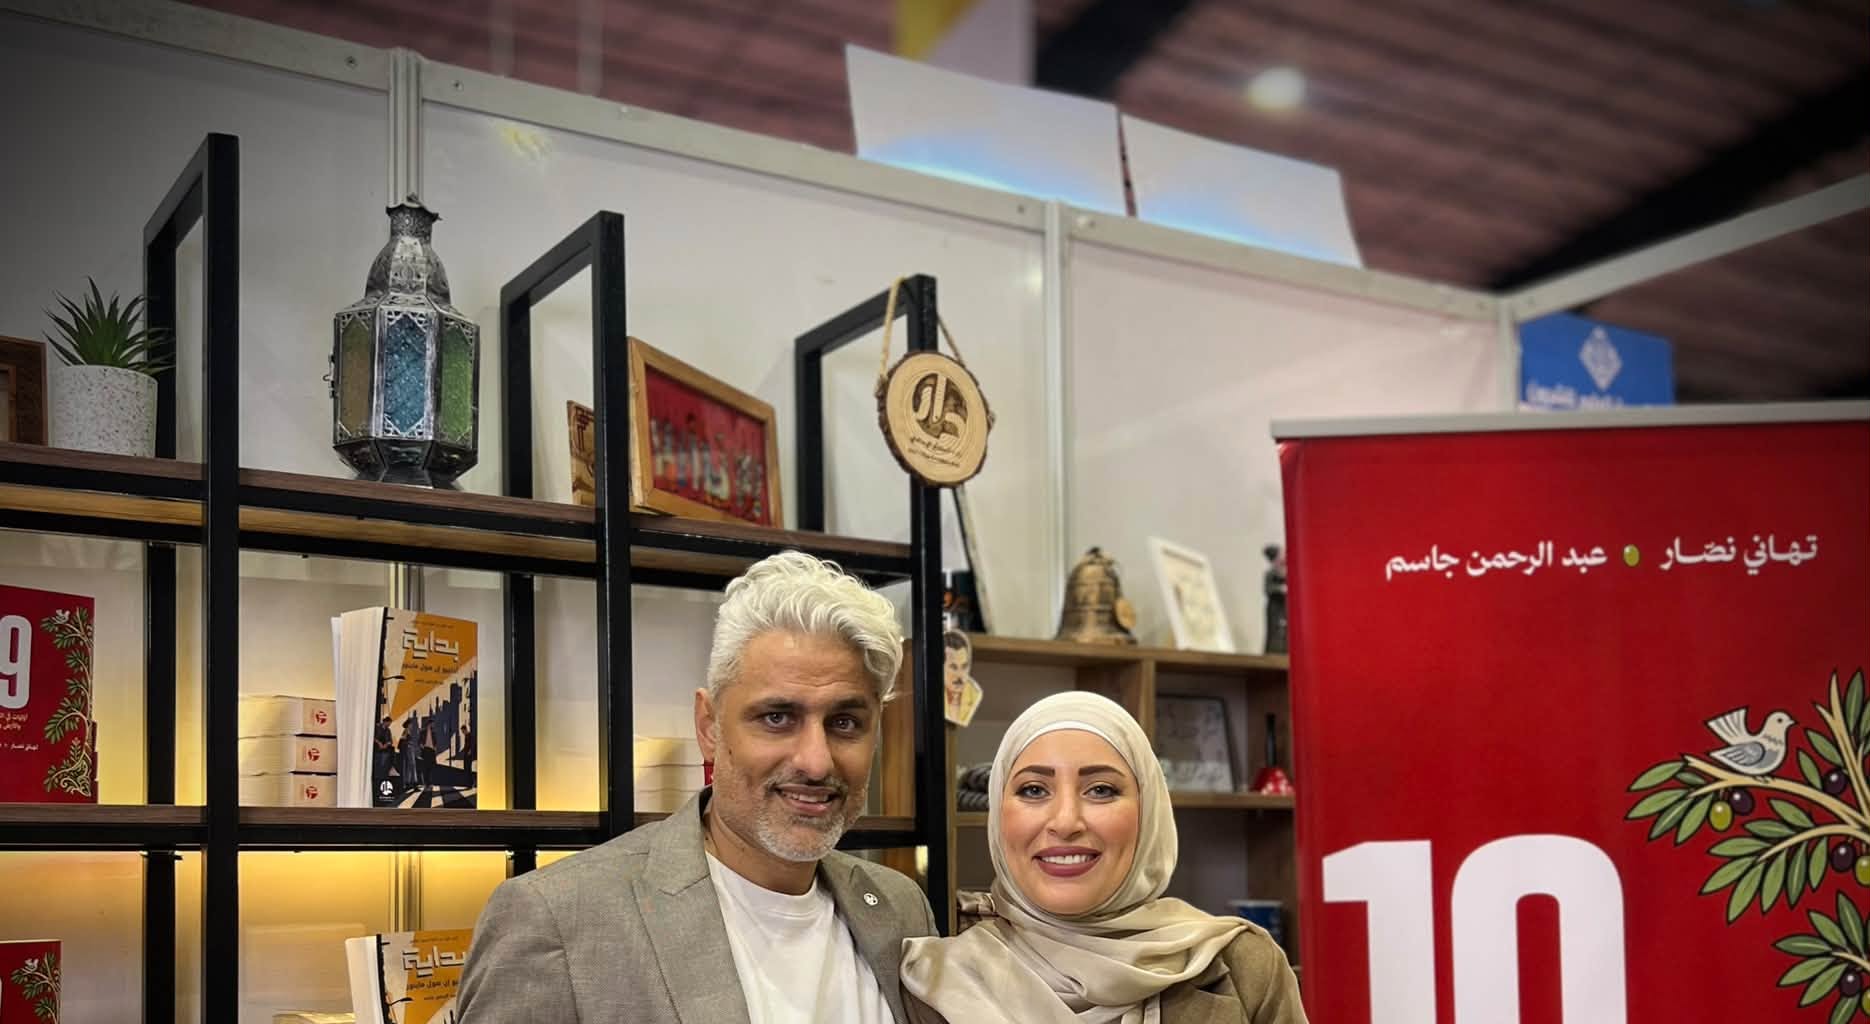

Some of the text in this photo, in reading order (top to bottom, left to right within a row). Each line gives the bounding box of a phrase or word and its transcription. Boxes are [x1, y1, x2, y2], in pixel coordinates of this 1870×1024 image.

[1385, 544, 1460, 582] جاسم
[1465, 540, 1554, 577] الرحمن
[1561, 546, 1608, 575] عبد
[1743, 533, 1819, 576] تهاني
[0, 614, 32, 710] 9
